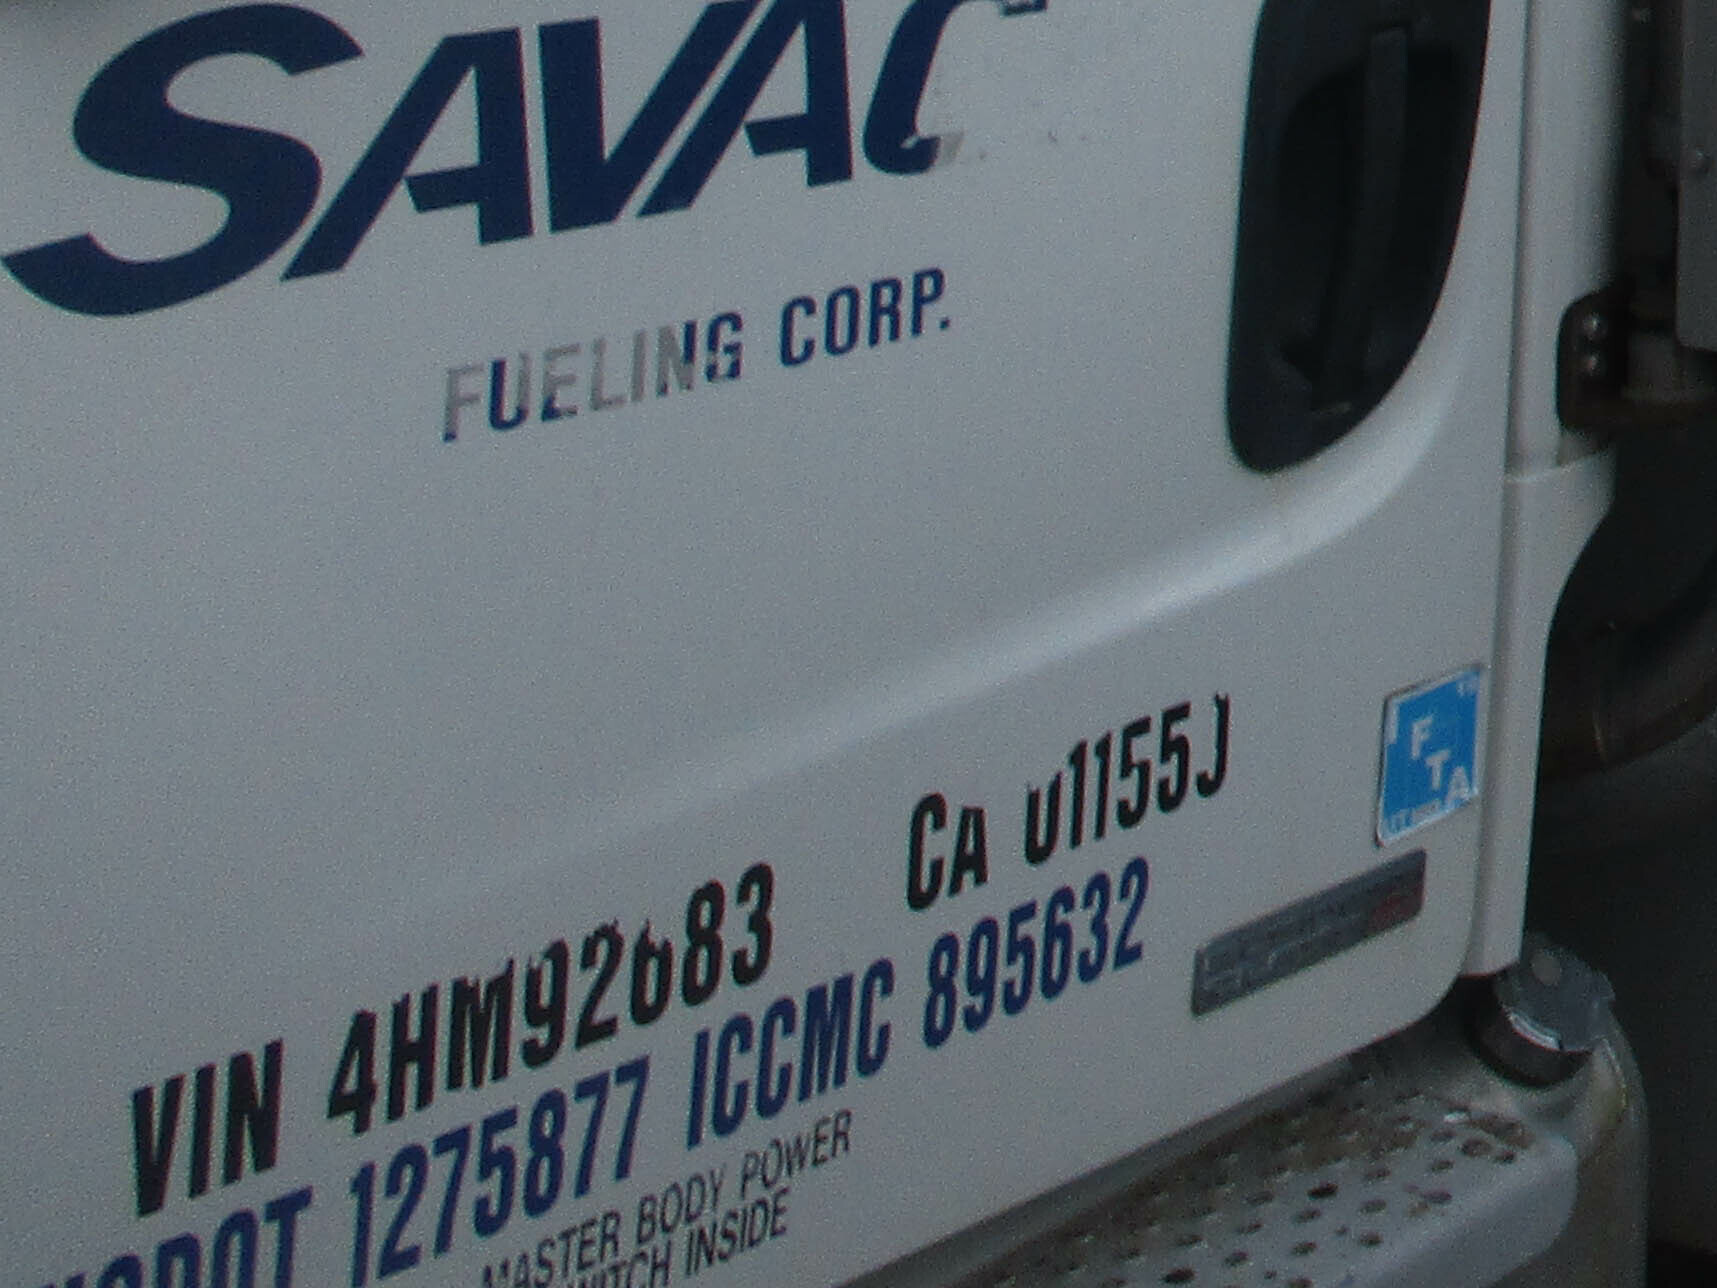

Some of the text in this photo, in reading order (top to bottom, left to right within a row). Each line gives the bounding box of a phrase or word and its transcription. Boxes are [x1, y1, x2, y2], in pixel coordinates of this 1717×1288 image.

[442, 267, 952, 442] FUELING CORP.
[132, 1038, 285, 1218] VIN
[348, 1056, 651, 1288] 1275877
[686, 959, 894, 1151] ICCMC
[922, 857, 1149, 1050] 895632
[483, 1110, 853, 1288] MASTER BODY POWER
[565, 1186, 792, 1288] ITCH INSIDE
